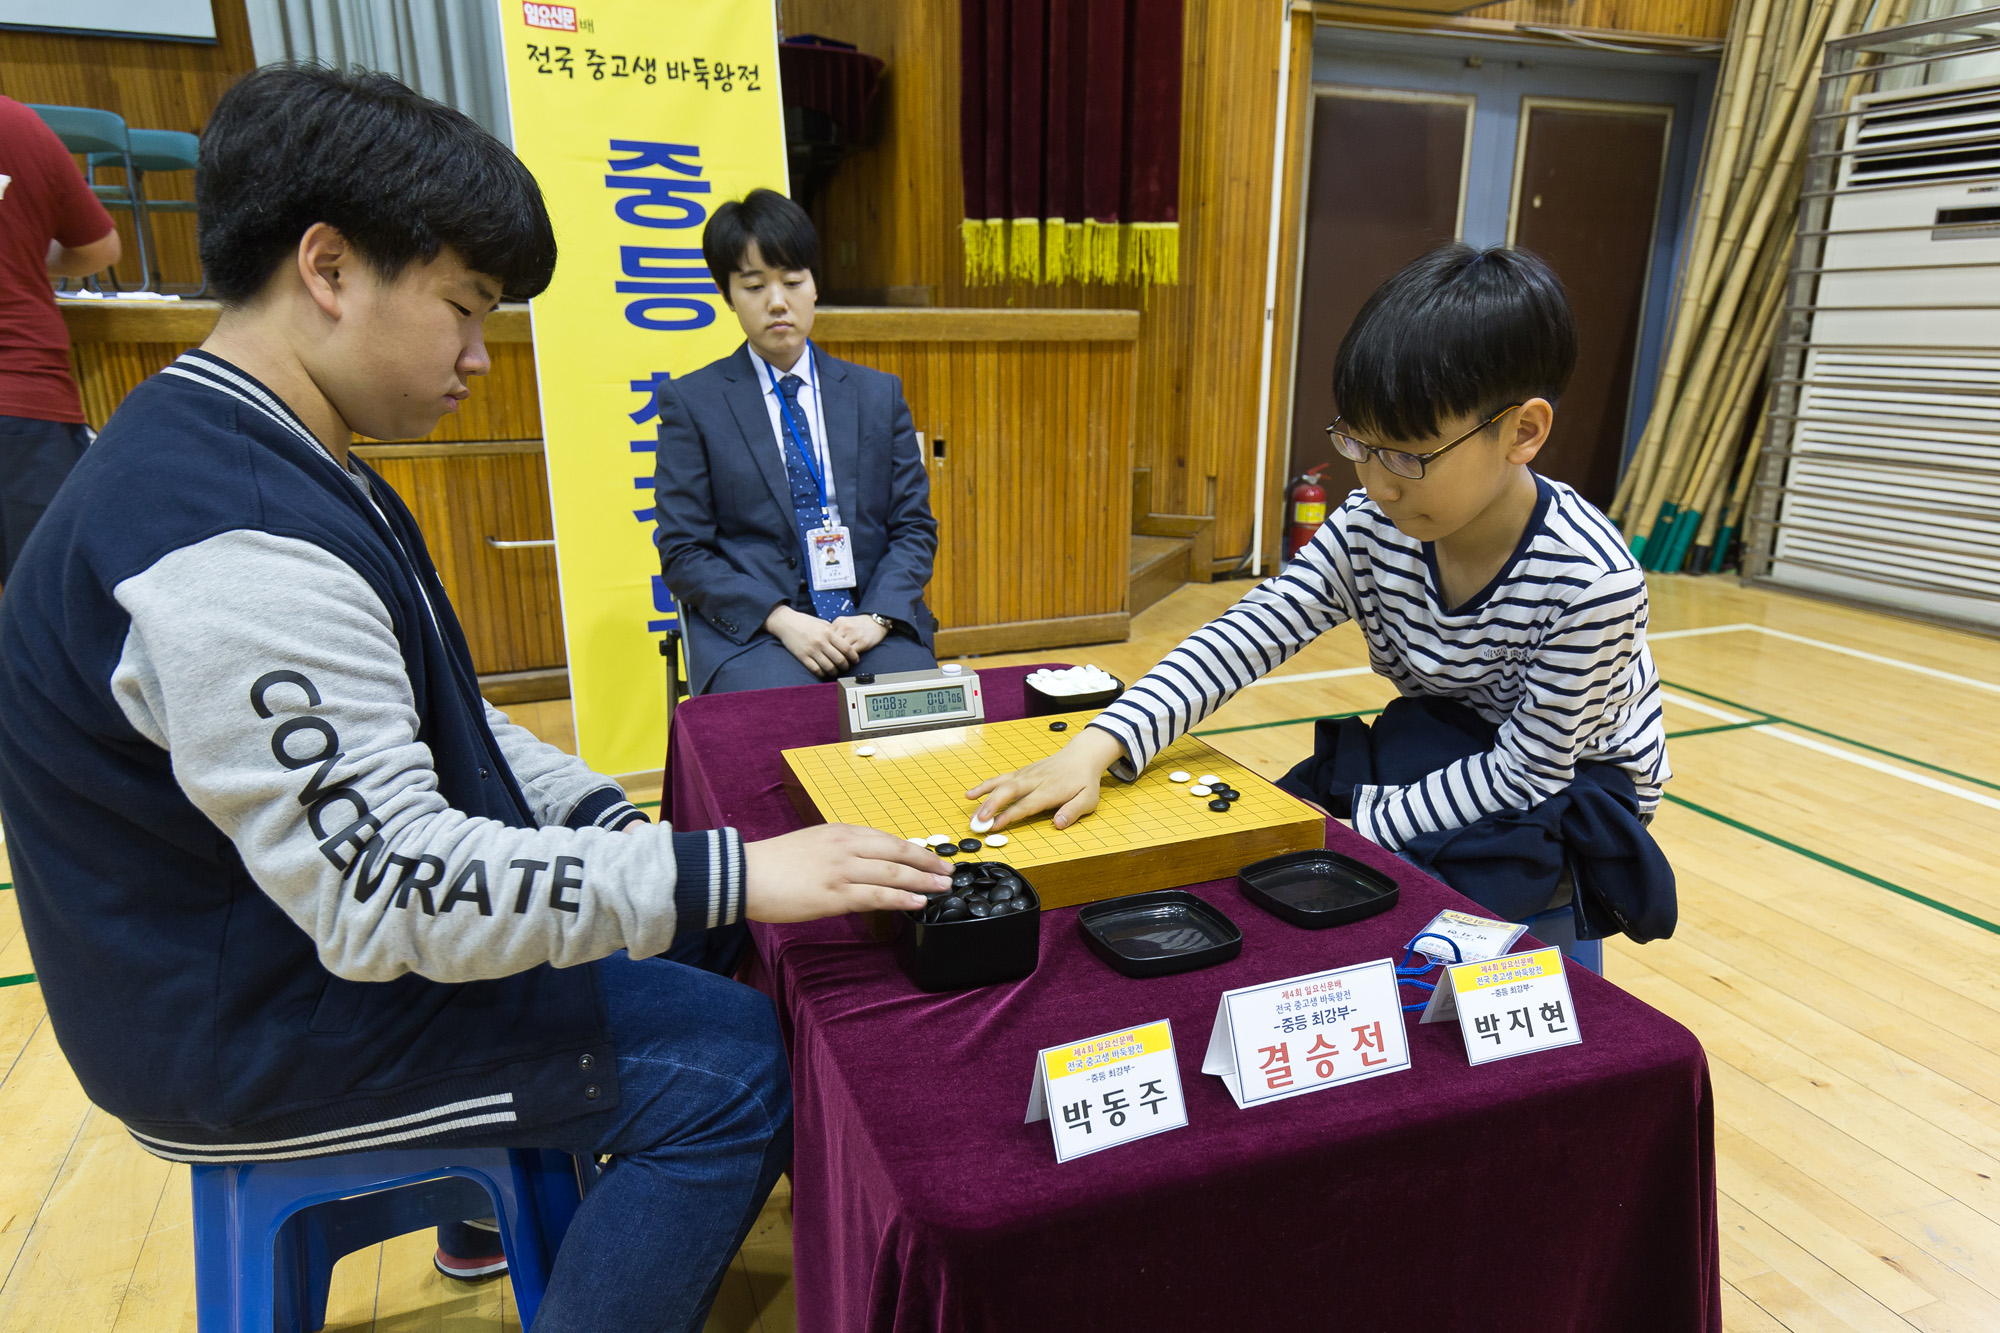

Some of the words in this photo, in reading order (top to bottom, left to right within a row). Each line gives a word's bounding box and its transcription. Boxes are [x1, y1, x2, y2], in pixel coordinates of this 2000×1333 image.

[523, 2, 577, 32] 일요신문
[579, 19, 595, 34] 배
[527, 44, 575, 79] 전국
[585, 48, 657, 85] 중고생
[666, 58, 761, 92] 바둑왕전
[250, 669, 584, 917] CONCENTRATE
[1476, 975, 1490, 986] 전국
[1492, 971, 1513, 983] 중고생
[1514, 965, 1543, 978] 바둑왕전
[1481, 963, 1499, 973] 제4회
[1500, 956, 1534, 970] 일요신문배
[1275, 1002, 1291, 1014] 전국
[1294, 997, 1318, 1011] 중고생
[1319, 989, 1351, 1004] 바둑왕전
[1281, 988, 1302, 999] 제4회
[1304, 979, 1342, 995] 일요신문배
[1474, 1000, 1568, 1045] 박지현
[1067, 1059, 1083, 1071] 전국
[1086, 1051, 1110, 1067] 중고생
[1111, 1043, 1144, 1059] 바둑왕전
[1073, 1044, 1094, 1057] 제4회
[1096, 1034, 1134, 1052] 일요신문배
[1257, 1021, 1388, 1089] 결승전
[1062, 1079, 1168, 1134] 박동주
